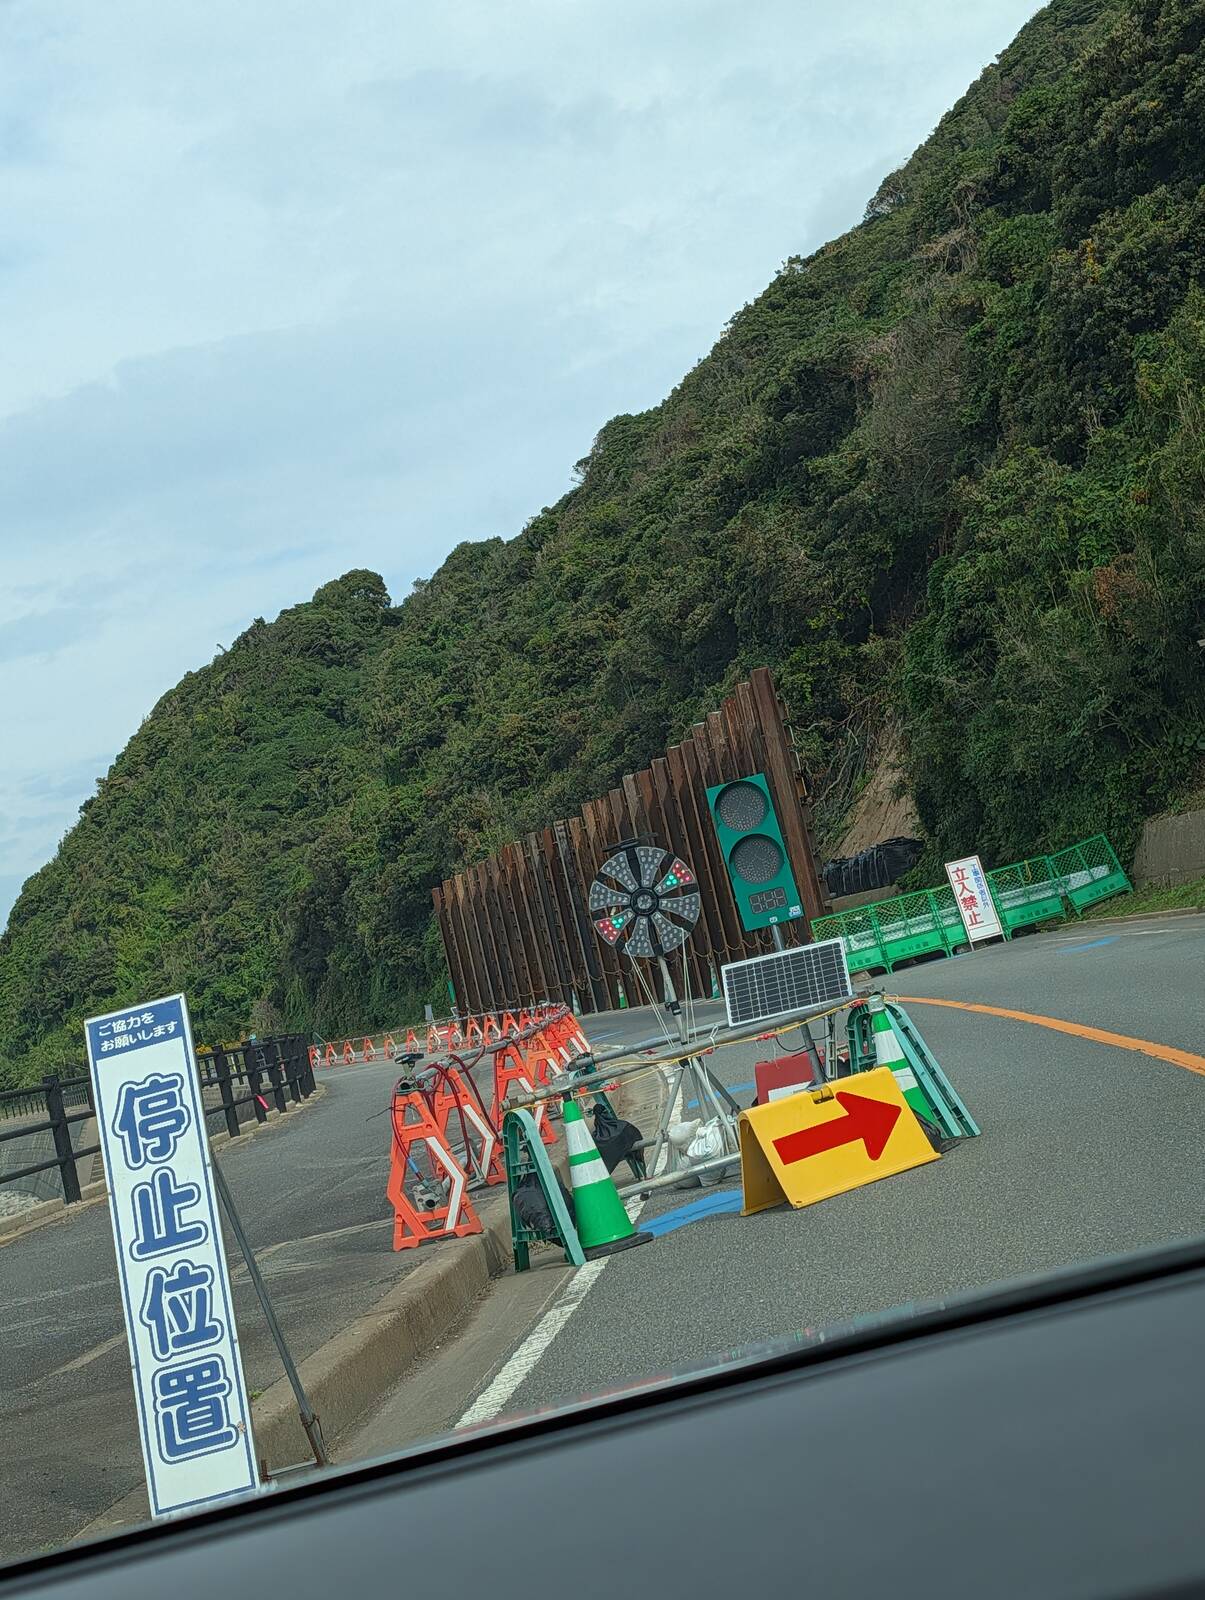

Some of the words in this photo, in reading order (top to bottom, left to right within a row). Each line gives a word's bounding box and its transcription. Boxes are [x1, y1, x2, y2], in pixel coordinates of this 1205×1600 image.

[951, 866, 984, 927] 立入禁止
[98, 1012, 155, 1036] ご協力を
[101, 1021, 178, 1052] お願いします
[112, 1072, 238, 1465] 停止位置
